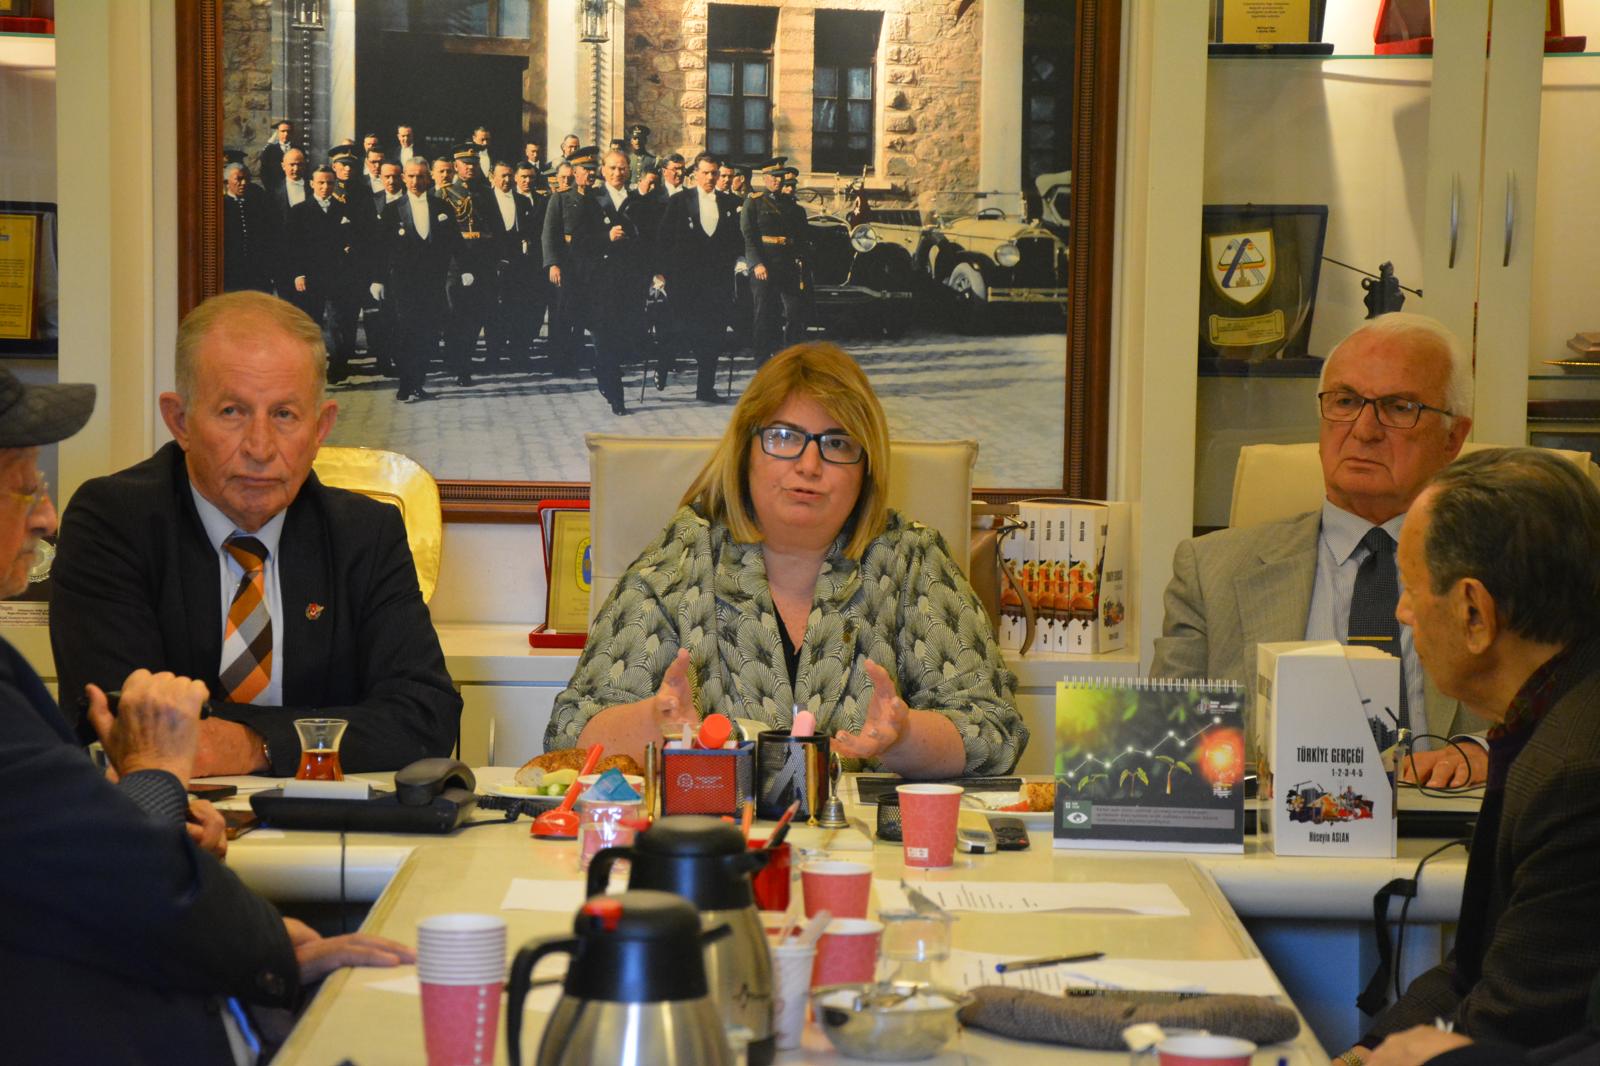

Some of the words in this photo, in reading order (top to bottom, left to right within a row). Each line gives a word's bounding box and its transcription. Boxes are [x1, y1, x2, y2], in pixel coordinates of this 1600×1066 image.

[1296, 746, 1329, 763] TÜRKİYE
[1331, 747, 1364, 765] GERÇEĞİ
[1331, 768, 1363, 777] 1-2-3-4-5
[1308, 831, 1330, 844] Hüseyin
[1331, 831, 1350, 843] ASLAN
